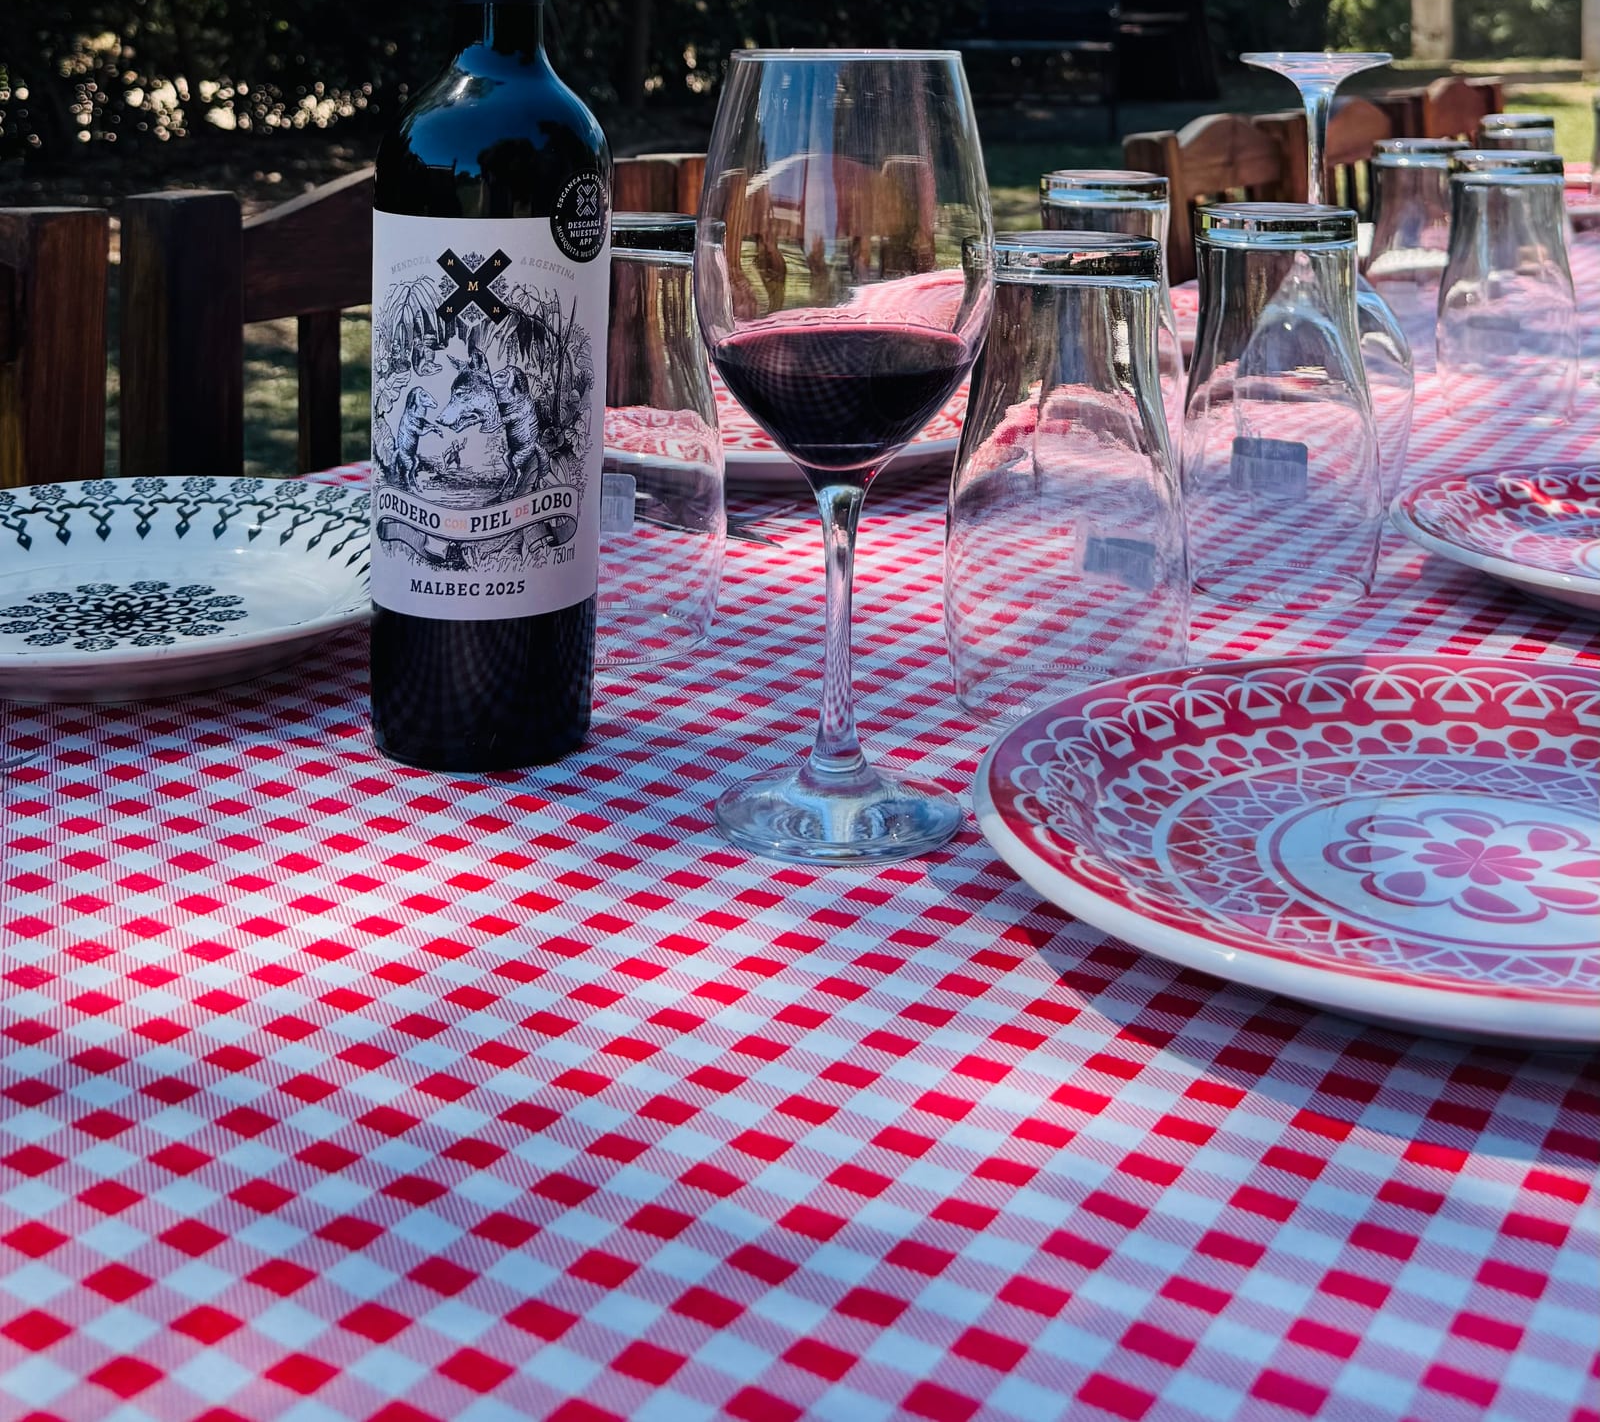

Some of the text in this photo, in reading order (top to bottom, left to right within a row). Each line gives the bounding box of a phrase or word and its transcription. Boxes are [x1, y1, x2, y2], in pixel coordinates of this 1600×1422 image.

[570, 228, 599, 238] NUESTRA
[580, 238, 593, 246] APP
[391, 256, 431, 274] MENDOZA
[520, 257, 575, 280] ARGENTINA
[467, 281, 479, 291] M
[379, 492, 572, 533] CORDERO CON PIEL DE LOBO
[410, 578, 525, 596] MALBEC 2025
